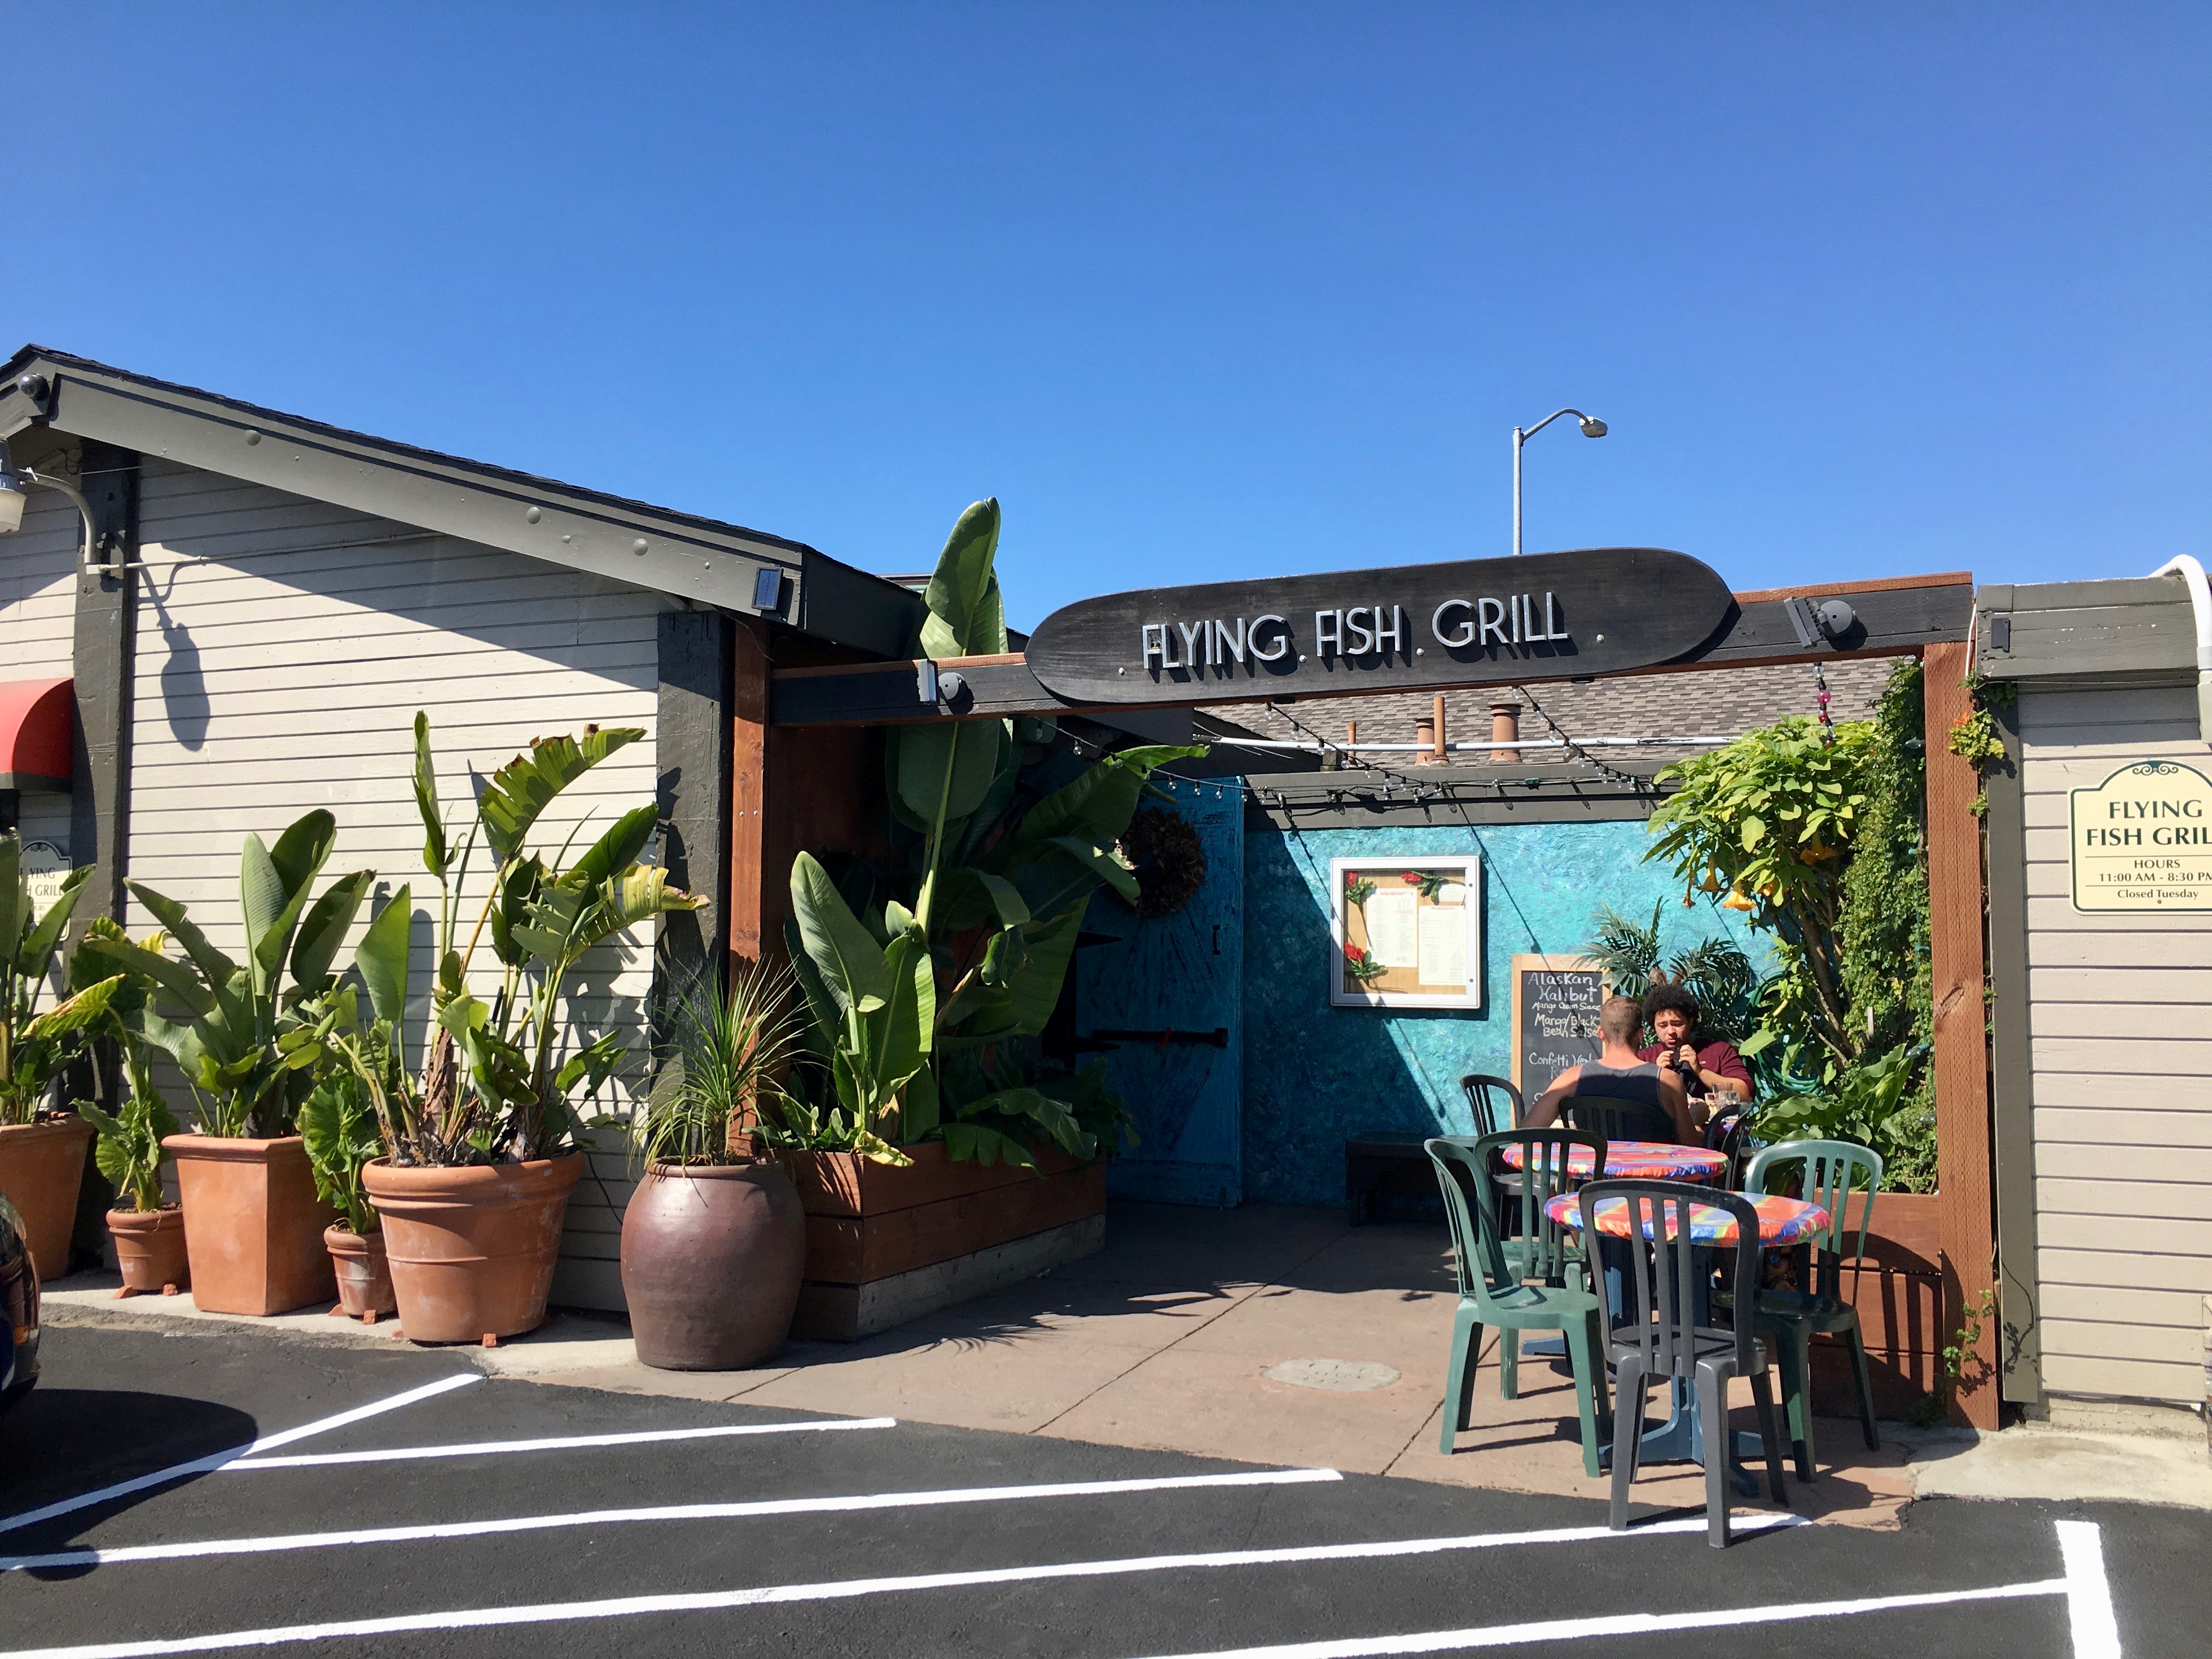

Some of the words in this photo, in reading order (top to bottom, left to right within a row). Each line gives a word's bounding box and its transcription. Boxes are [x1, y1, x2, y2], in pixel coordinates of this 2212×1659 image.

[1142, 614, 1289, 669] FLYING
[1315, 605, 1403, 657] FISH
[1432, 592, 1570, 647] GRILL
[2109, 800, 2202, 819] FLYING
[2087, 828, 2142, 846] FISH
[2134, 859, 2180, 868] HOURS
[20, 867, 55, 879] YING
[2099, 873, 2131, 882] 11:00
[2135, 872, 2155, 882] AM
[2168, 872, 2193, 882] 8:30
[2118, 889, 2153, 899] Closed
[2156, 889, 2199, 900] Tuesday
[1538, 986, 1598, 1003] Halibut
[1528, 1052, 1568, 1066] Confetti
